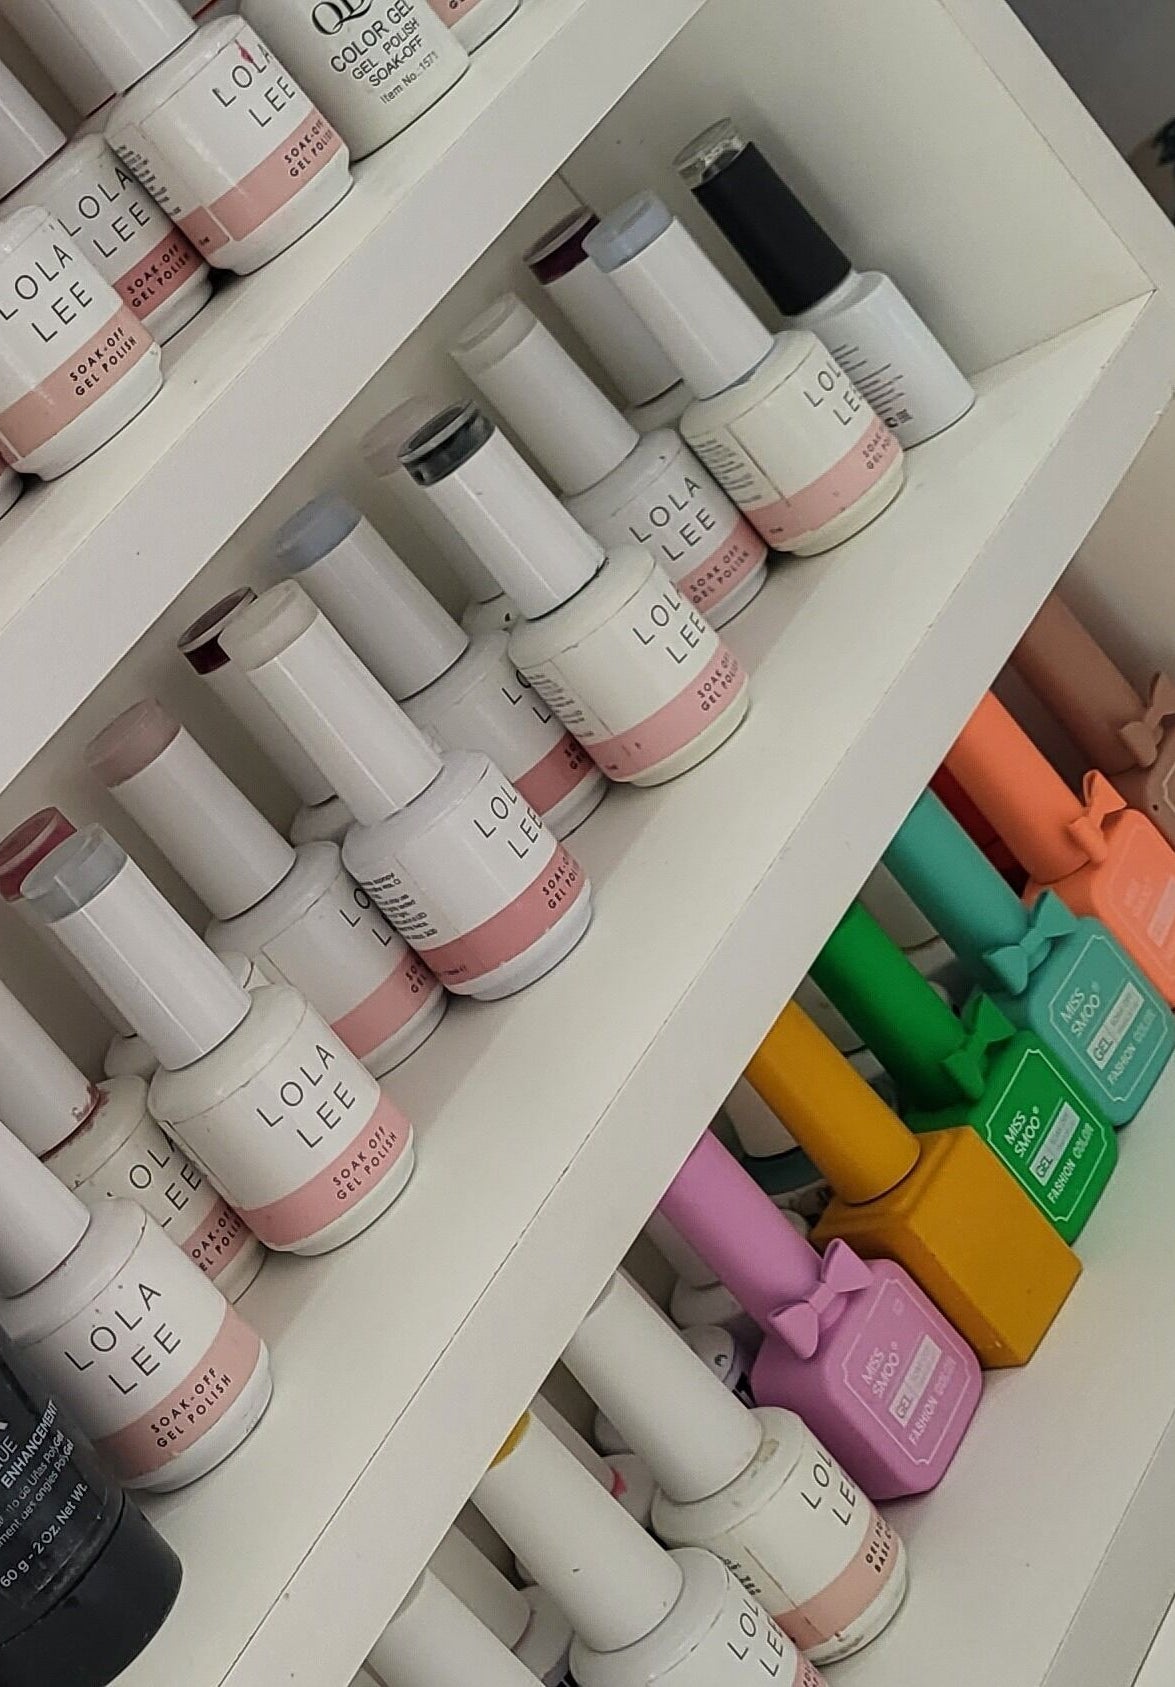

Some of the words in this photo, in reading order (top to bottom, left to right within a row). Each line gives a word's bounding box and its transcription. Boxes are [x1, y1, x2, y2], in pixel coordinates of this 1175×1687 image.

[330, 20, 390, 73] COLOR
[386, 0, 414, 25] GEL
[351, 57, 380, 81] GEL
[382, 17, 420, 56] POLISH
[368, 34, 425, 87] SOAK-OFF
[249, 76, 296, 127] LEE
[379, 84, 404, 104] Item
[289, 158, 312, 177] GEL
[58, 167, 133, 237] LOLA
[93, 201, 150, 258] LEE
[31, 281, 93, 342] LEE
[132, 287, 155, 308] GEL
[69, 326, 125, 382] SOAK-OFF
[75, 375, 100, 396] GEL
[102, 336, 137, 374] POLISH
[629, 476, 702, 544] LOLA
[662, 508, 716, 562] LEE
[690, 565, 720, 592] SOAK
[692, 586, 716, 604] GEL
[632, 590, 681, 645] LOL
[665, 611, 706, 664] LEE
[697, 668, 723, 699] SOAK
[700, 690, 722, 712] GEL
[548, 889, 566, 910] GEL
[1060, 987, 1086, 1023] MISS
[1071, 994, 1101, 1038] SMOO
[1093, 1037, 1114, 1062] GEL
[1107, 1043, 1137, 1085] FASHION
[256, 1044, 335, 1127] LOLA
[296, 1081, 356, 1148] LEE
[1004, 1110, 1027, 1145] MISS
[1014, 1116, 1041, 1158] SMOO
[332, 1150, 367, 1187] SOAK
[369, 1125, 387, 1150] OFF
[336, 1177, 362, 1201] GEL
[364, 1131, 397, 1176] POLISH
[1035, 1156, 1054, 1179] GEL
[1047, 1160, 1076, 1204] FASHION
[1073, 1123, 1095, 1158] COLOR
[161, 1163, 202, 1228] EE
[64, 1283, 162, 1371] LOLA
[108, 1323, 181, 1394] LEE
[861, 1347, 885, 1385] MISS
[872, 1352, 900, 1398] SMOO
[151, 1367, 218, 1433] SOAK-OFF
[157, 1426, 184, 1448] GEL
[187, 1374, 232, 1424] POLISH
[908, 1395, 938, 1446] FASHION
[0, 1399, 59, 1489] ENHANCEMENT
[0, 1569, 19, 1588] 60
[15, 1559, 30, 1575] g
[32, 1540, 45, 1557] 2
[56, 1500, 78, 1525] Net
